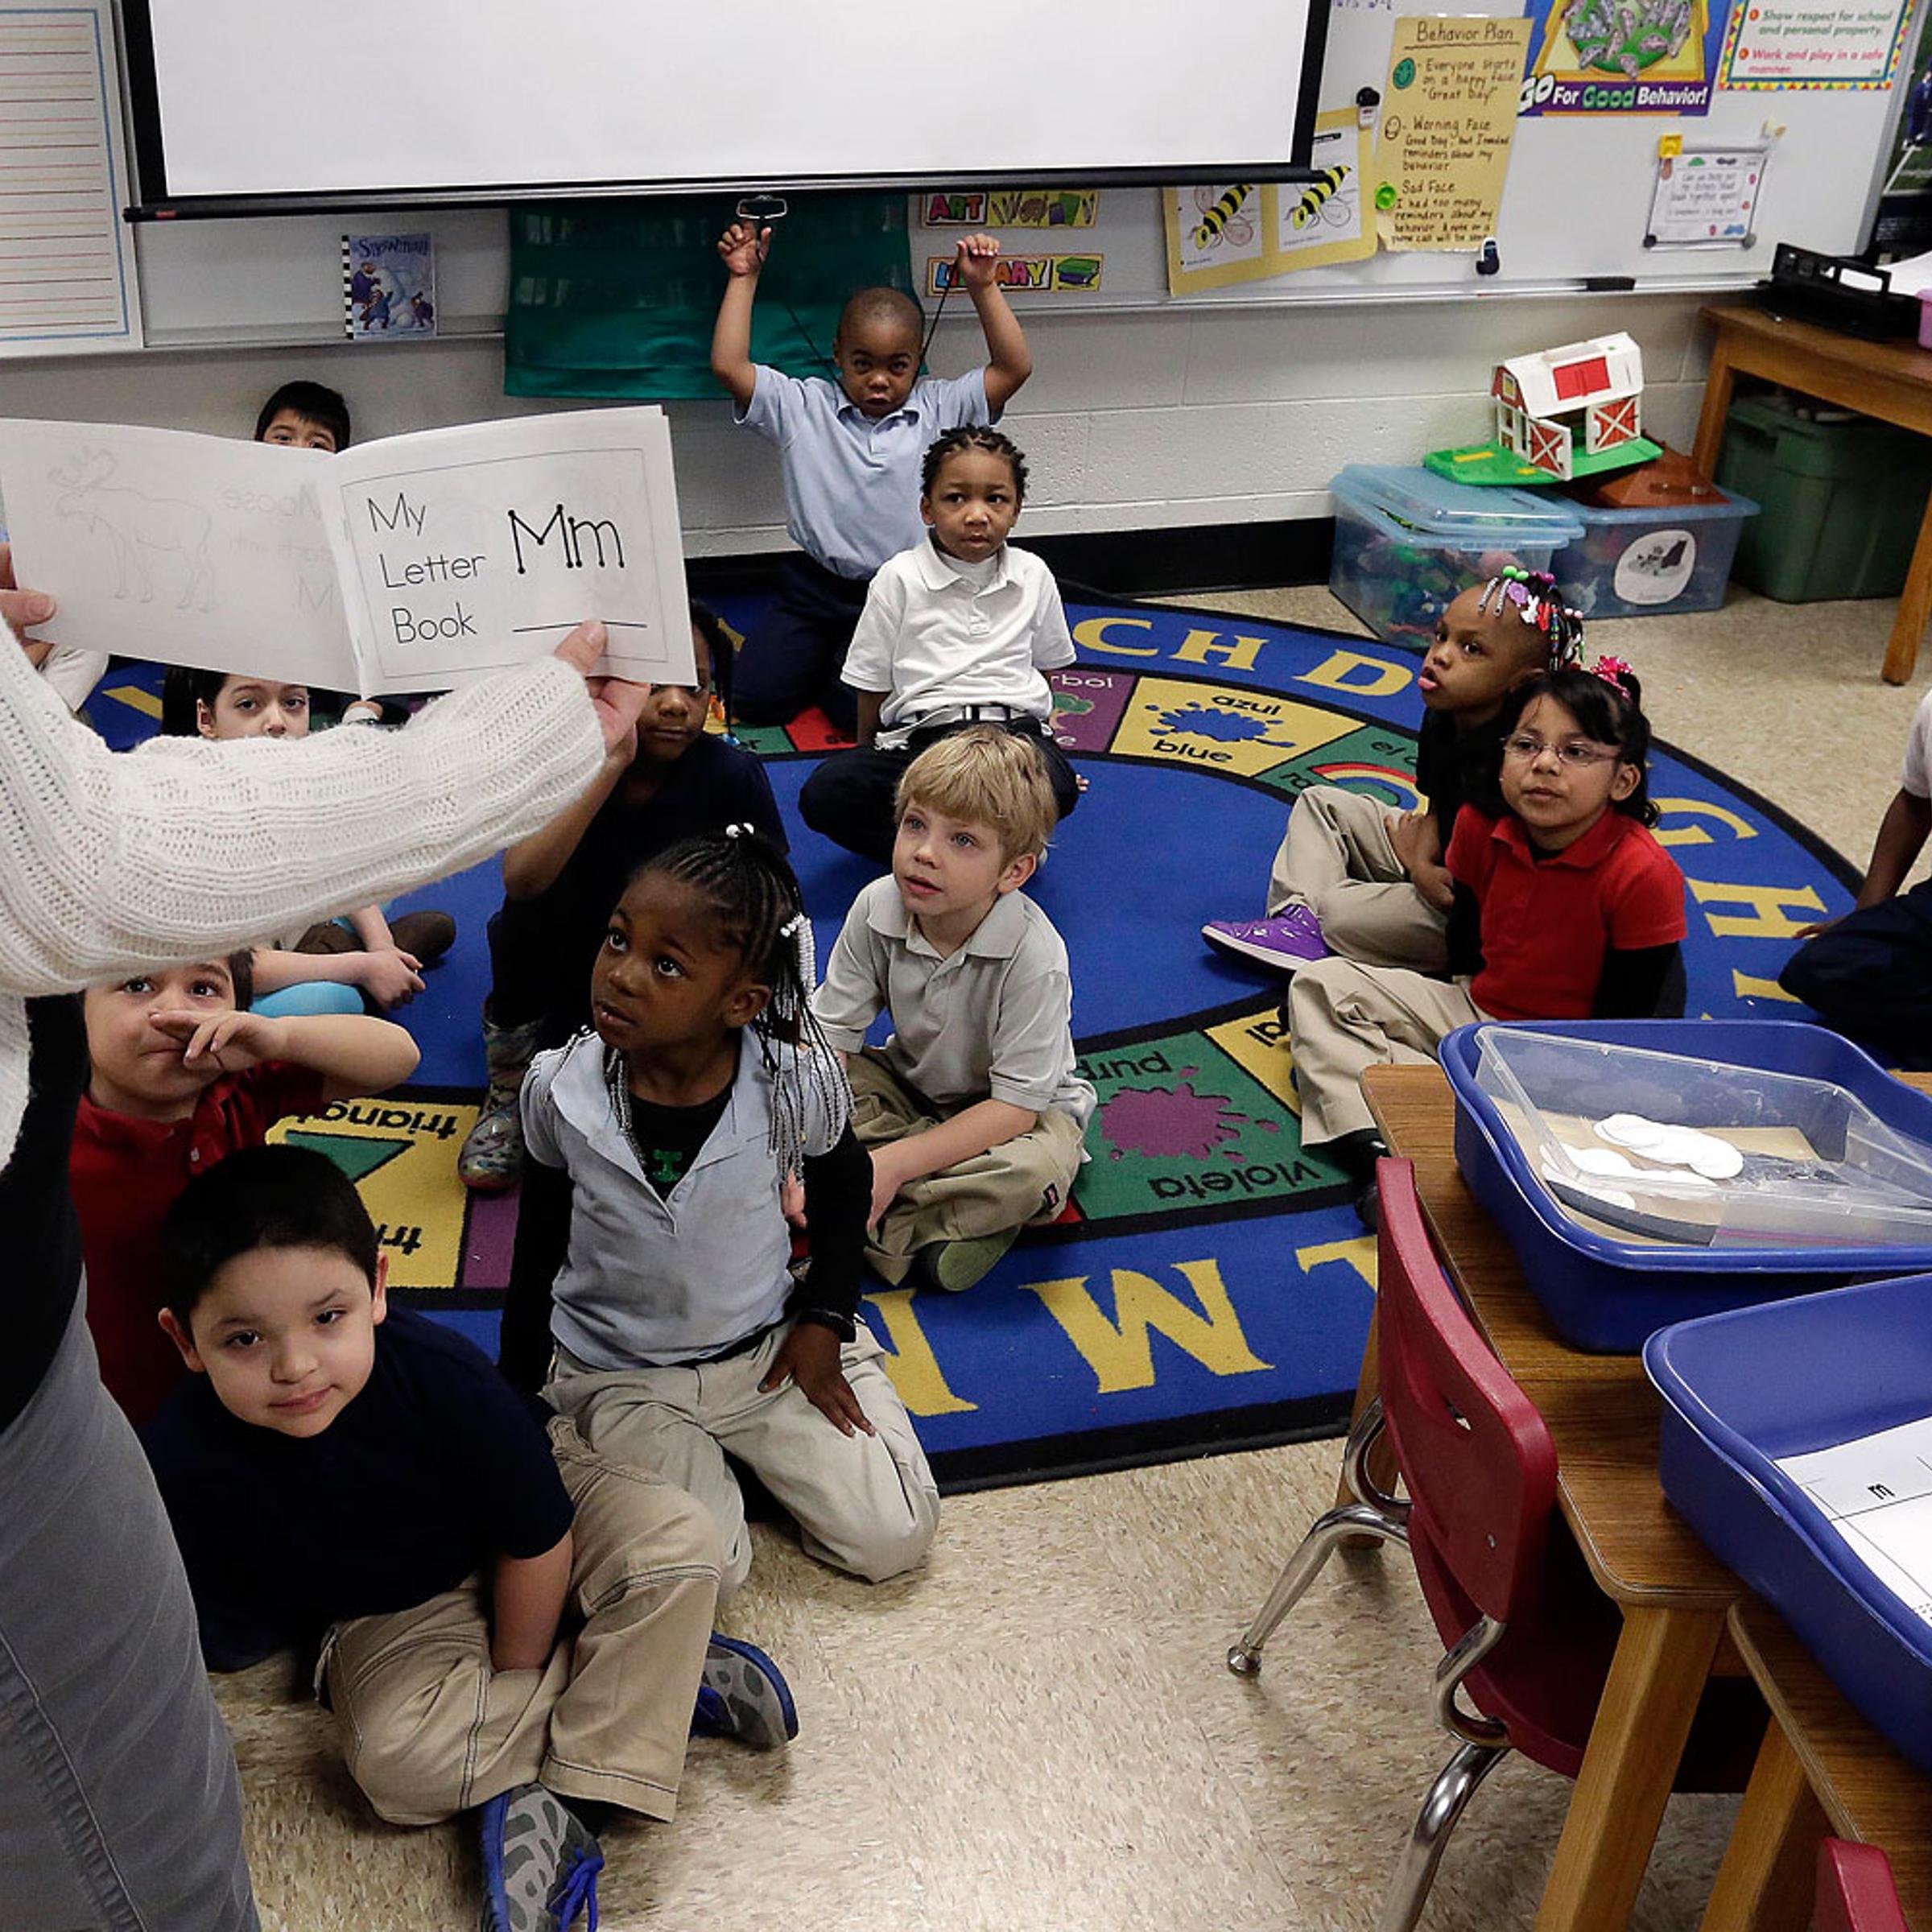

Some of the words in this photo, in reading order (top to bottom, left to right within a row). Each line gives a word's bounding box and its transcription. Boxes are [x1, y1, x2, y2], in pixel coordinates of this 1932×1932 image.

[1763, 10, 1792, 21] Show
[1796, 11, 1835, 23] respect
[1839, 10, 1855, 22] for
[1857, 9, 1893, 22] school
[1417, 20, 1480, 42] Behavior
[1484, 22, 1514, 39] Plan
[1759, 24, 1781, 35] and
[1783, 24, 1832, 38] personal
[1752, 48, 1782, 60] Work
[1785, 49, 1808, 60] and
[1809, 48, 1834, 62] play
[1861, 48, 1885, 60] safe
[1425, 59, 1475, 76] Everyone
[1484, 59, 1517, 70] starts
[1457, 75, 1486, 89] happy
[1517, 73, 1555, 115] GO
[1553, 86, 1580, 105] For
[1582, 85, 1637, 109] Good
[1637, 86, 1708, 105] Behavior!
[1414, 116, 1459, 138] Warning
[1466, 118, 1491, 130] Face
[1406, 134, 1426, 146] Good
[1402, 148, 1448, 159] reminders
[1402, 179, 1424, 194] Sad
[1429, 180, 1455, 193] Face
[929, 195, 985, 221] ART
[1394, 212, 1445, 221] reminders
[1451, 209, 1476, 220] about
[1409, 198, 1429, 209] had
[1454, 199, 1483, 212] many
[935, 260, 1047, 288] LIARY
[368, 492, 426, 537] My
[507, 503, 625, 574] Mm
[379, 553, 487, 588] Letter
[391, 601, 477, 644] Book
[1051, 674, 1113, 689] rbol
[1291, 649, 1414, 697] D
[1212, 695, 1282, 716] azul
[1153, 739, 1233, 762] blue
[1684, 876, 1829, 939] H
[1074, 1051, 1172, 1081] purp
[296, 1100, 458, 1140] triang
[1147, 1159, 1323, 1199] violeta
